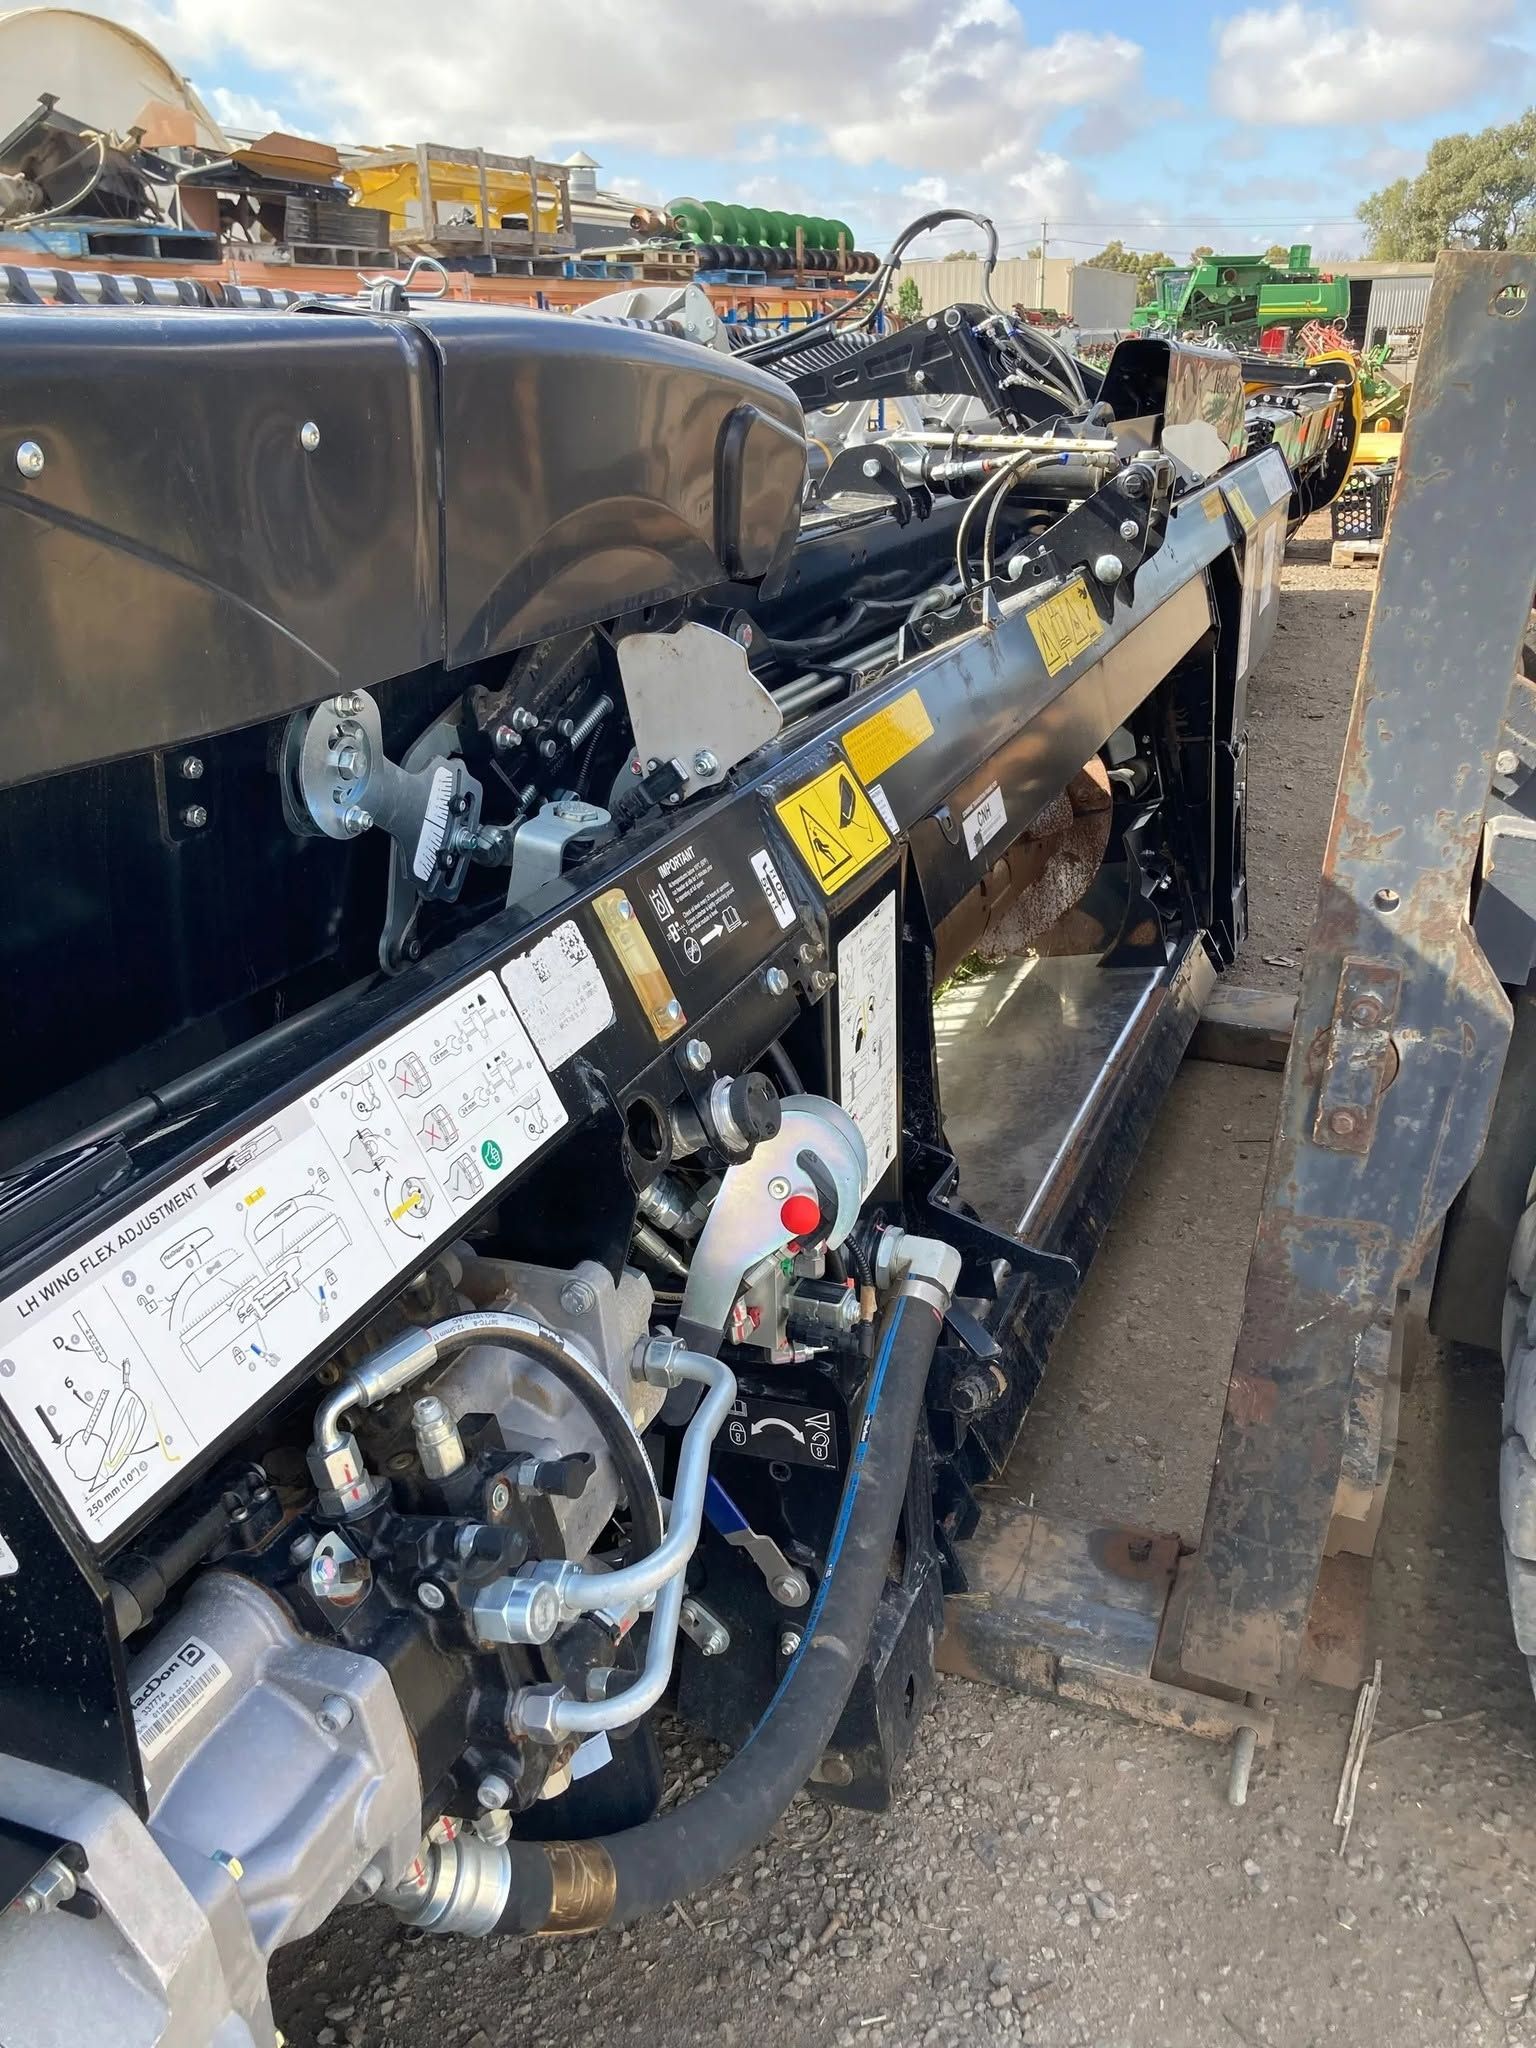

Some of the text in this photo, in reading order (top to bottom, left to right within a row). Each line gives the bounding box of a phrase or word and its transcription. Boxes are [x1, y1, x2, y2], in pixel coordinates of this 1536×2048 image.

[976, 802, 991, 826] CNH
[656, 845, 695, 879] IMPORTANT
[16, 1182, 197, 1318] LH WING FLEX ADJUSTMENT
[52, 1336, 64, 1349] D
[64, 1376, 74, 1389] 6
[85, 1498, 105, 1517] 250
[102, 1485, 120, 1502] mm
[141, 1691, 165, 1716] 337774
